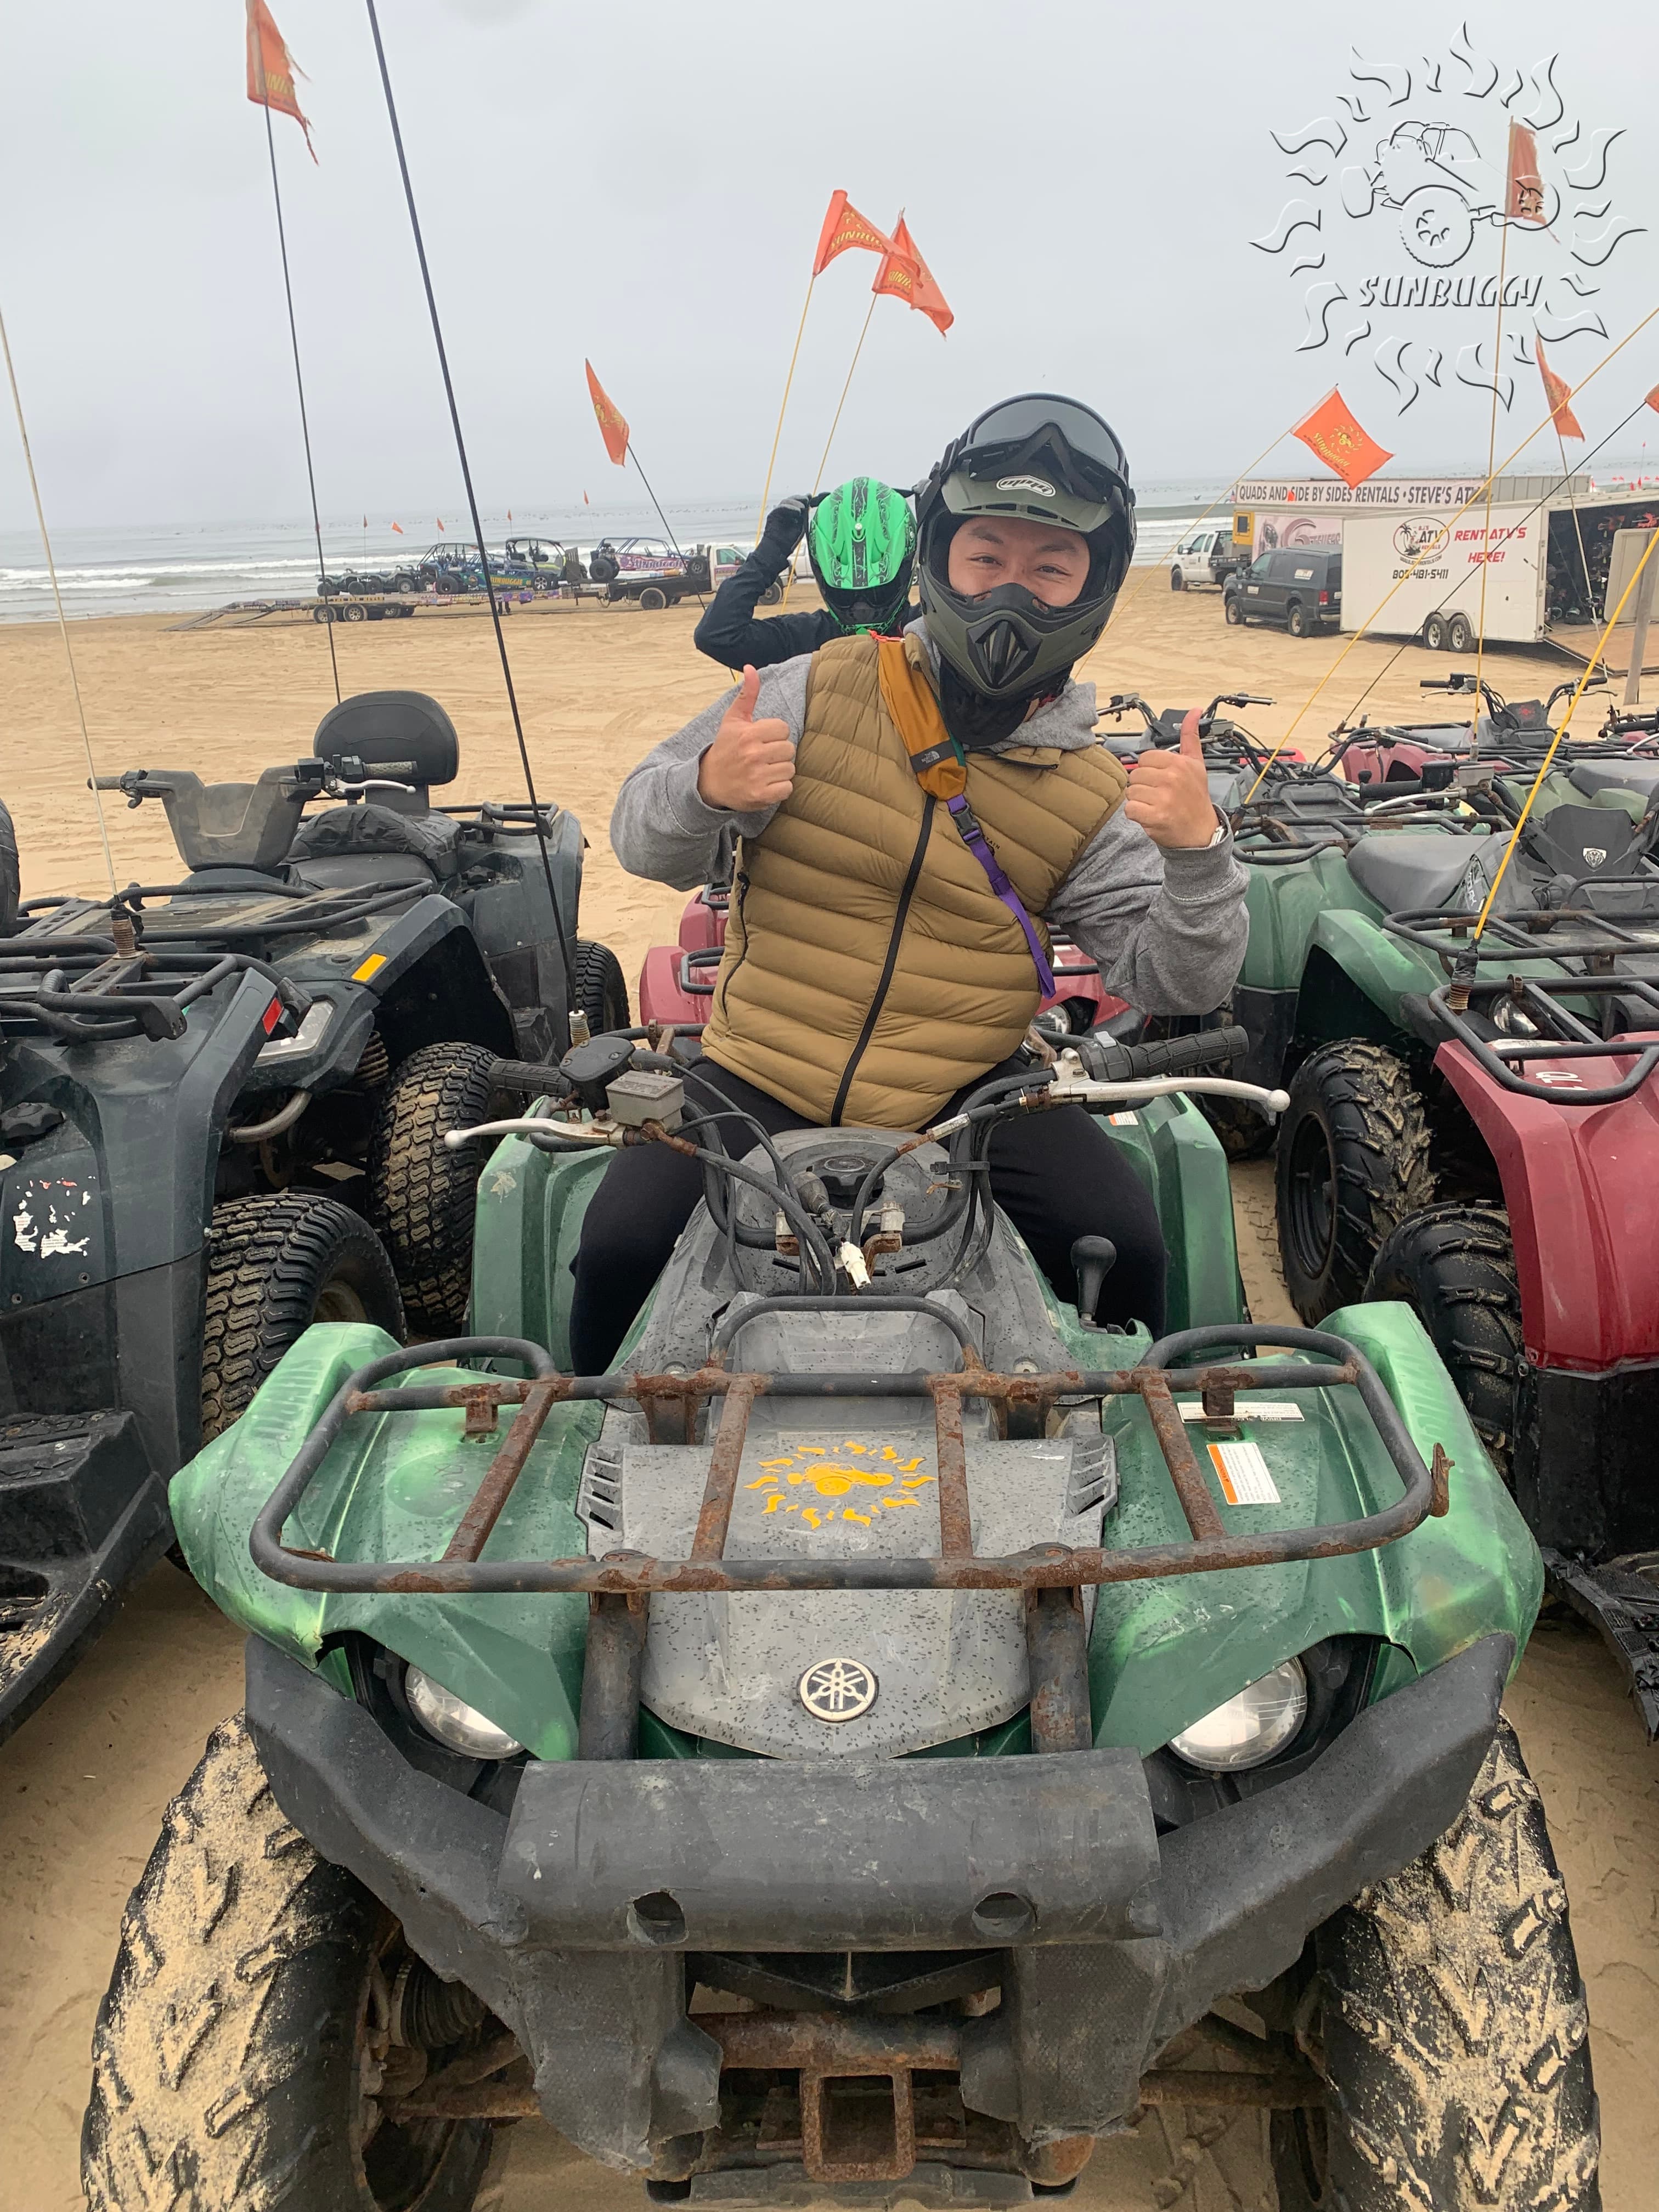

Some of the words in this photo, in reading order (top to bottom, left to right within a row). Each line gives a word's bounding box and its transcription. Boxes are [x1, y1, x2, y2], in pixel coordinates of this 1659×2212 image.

[1239, 485, 1267, 500] QUADS
[1268, 486, 1288, 501] AND
[1312, 486, 1324, 502] BY
[1325, 486, 1352, 503] SIDES
[1355, 486, 1400, 503] RENTALS
[1408, 487, 1452, 504] STEVE'S
[1419, 530, 1444, 543] ATV
[1454, 529, 1487, 541] RENT
[1488, 527, 1528, 540] ATV'S
[1468, 551, 1505, 563] HERE!
[1392, 569, 1449, 580] 805-481-5411
